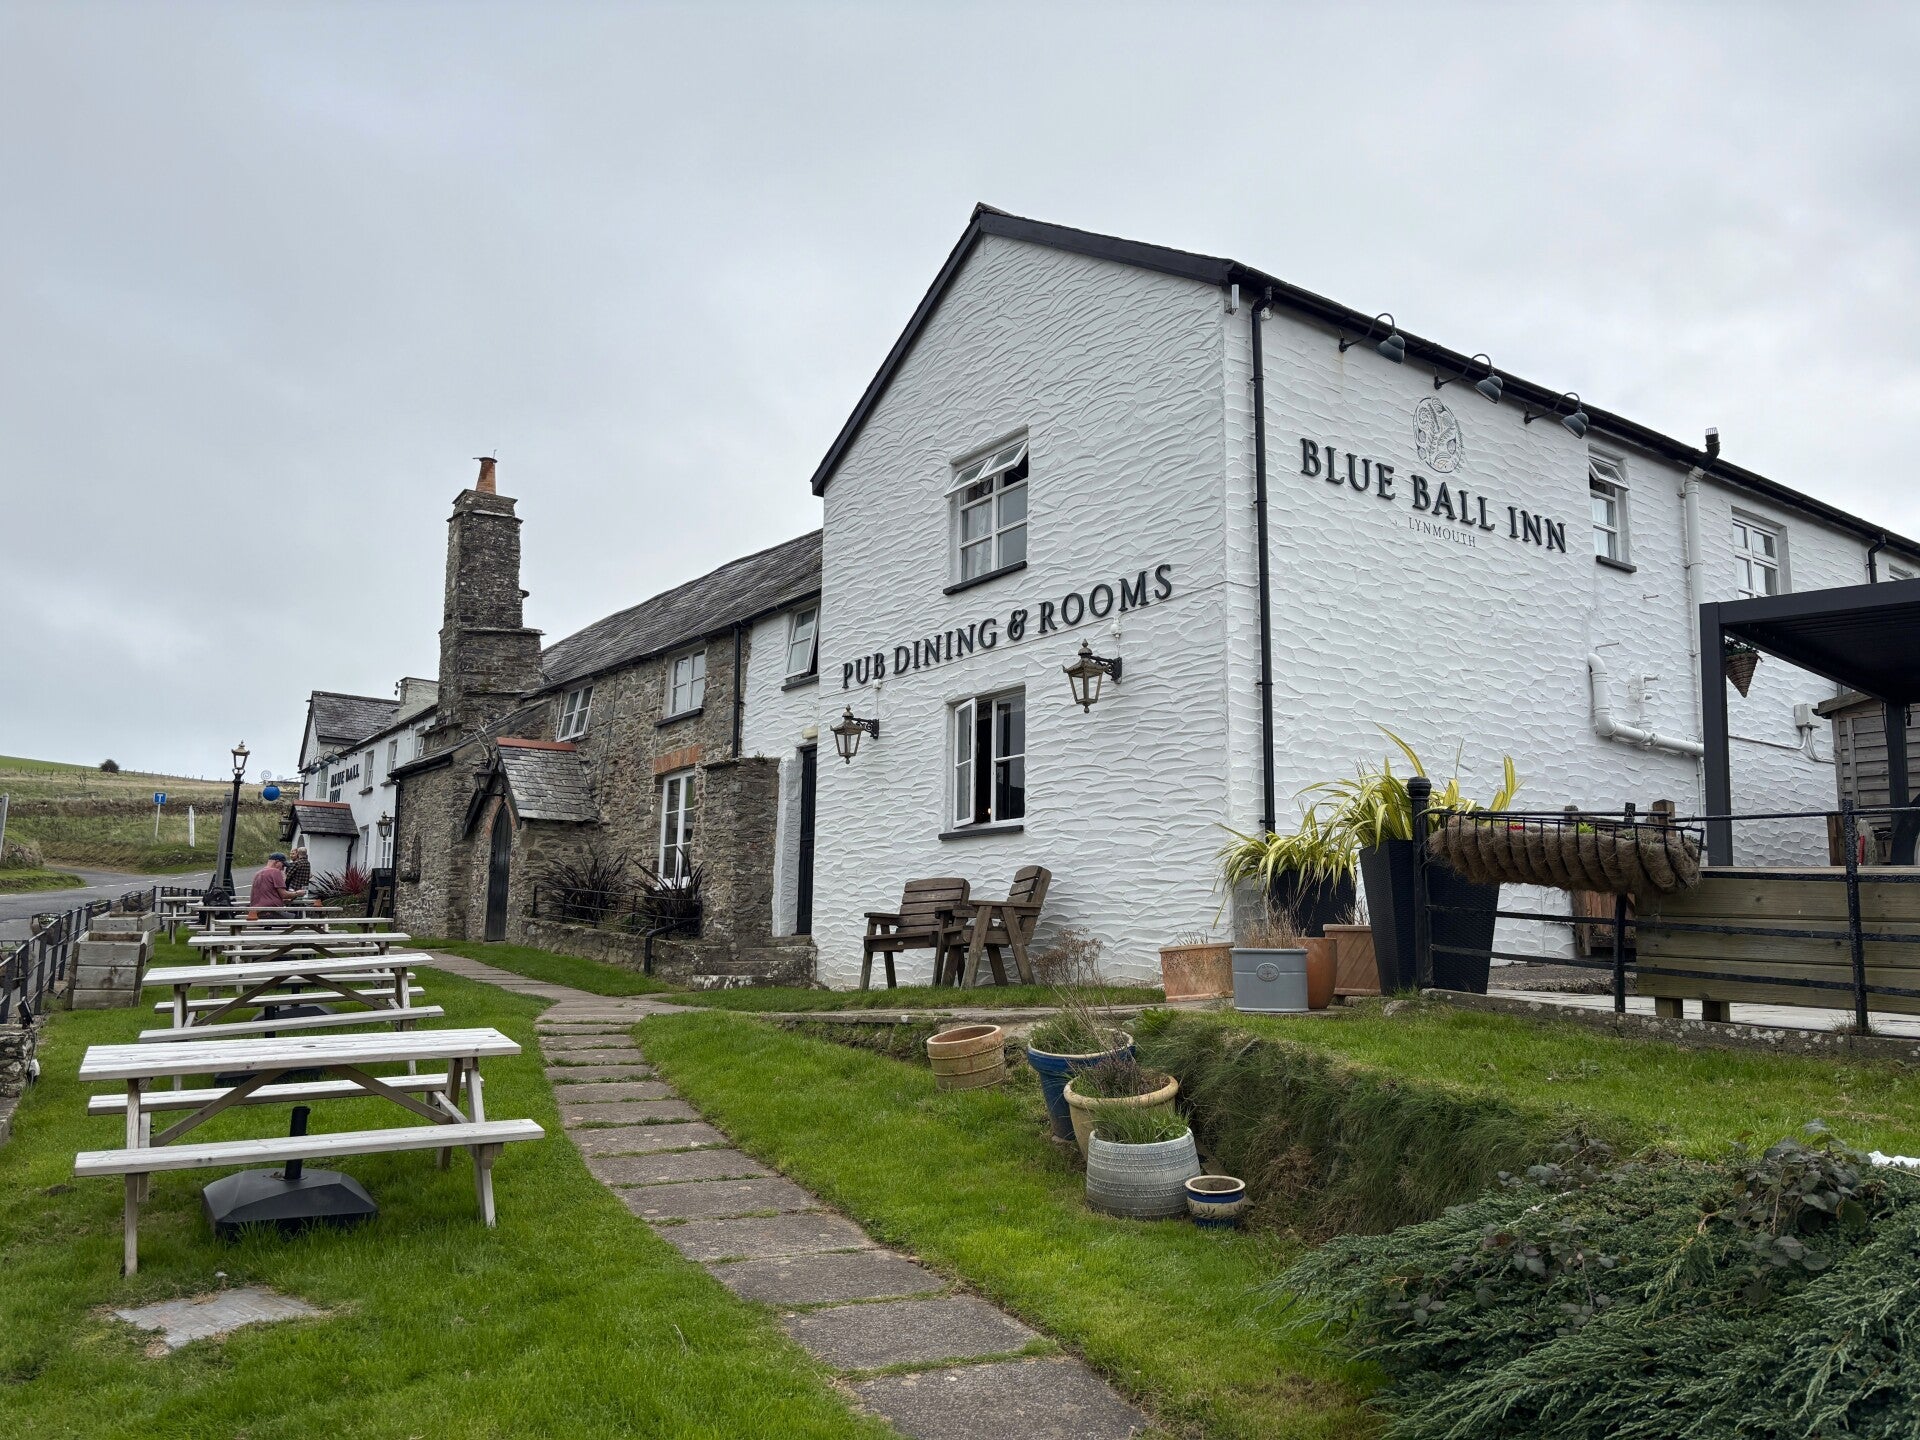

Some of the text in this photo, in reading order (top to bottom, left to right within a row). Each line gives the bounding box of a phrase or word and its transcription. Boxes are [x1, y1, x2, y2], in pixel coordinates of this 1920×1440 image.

[1300, 437, 1567, 553] BLUE BALL INN
[1409, 517, 1477, 548] LYNMOUTH
[842, 564, 1173, 689] PUB DINING & ROOMS
[330, 763, 360, 788] BLUE BALL
